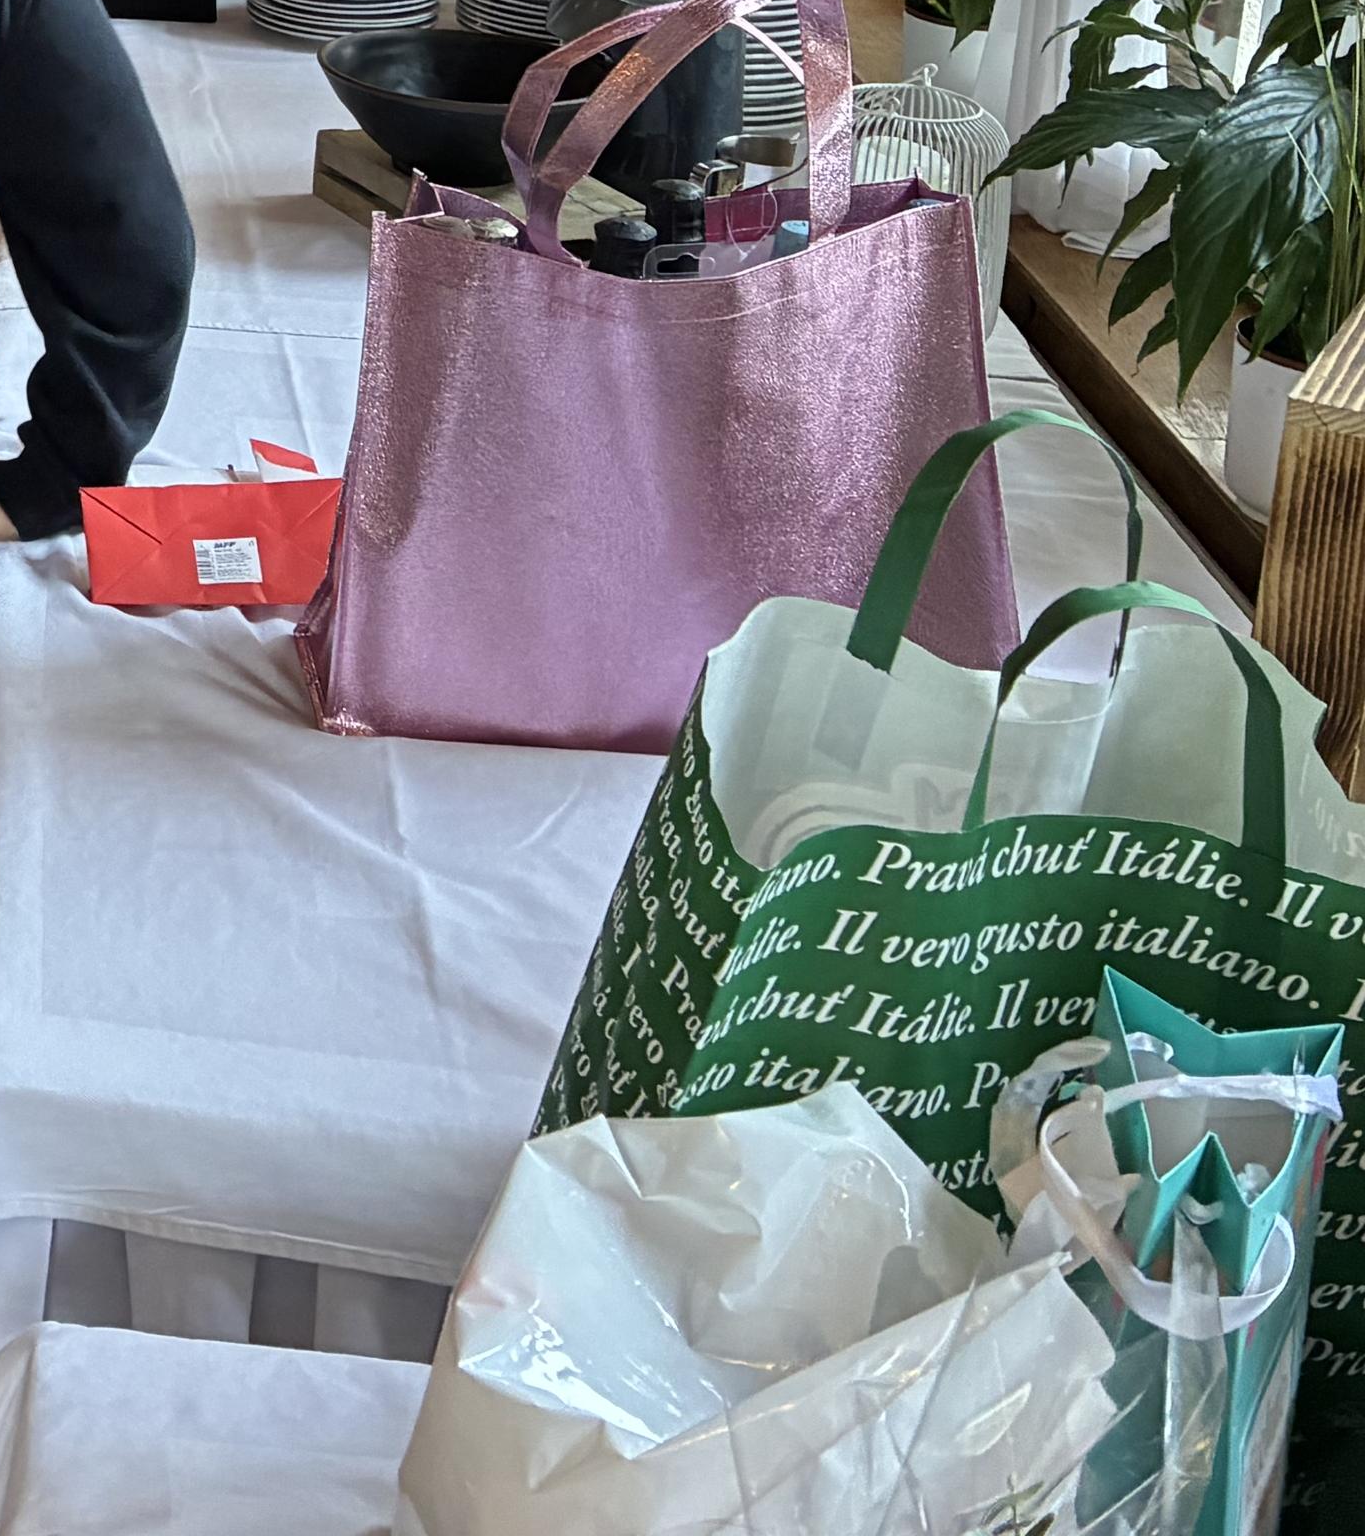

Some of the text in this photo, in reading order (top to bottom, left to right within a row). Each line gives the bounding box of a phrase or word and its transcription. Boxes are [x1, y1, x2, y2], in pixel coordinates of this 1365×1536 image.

[857, 836, 991, 894] Pravá
[991, 824, 1098, 880] chuť
[1093, 829, 1250, 909] Itálie.
[1266, 877, 1325, 930] Il
[712, 916, 803, 987] Itálie.
[816, 908, 879, 956] Il
[881, 932, 971, 970] vero
[970, 914, 1084, 976] gusto
[1094, 908, 1320, 1010] italiano.
[736, 975, 855, 1025] chuť
[849, 991, 977, 1046] Itálie.
[986, 978, 1030, 1031] Il
[1033, 995, 1099, 1027] ver
